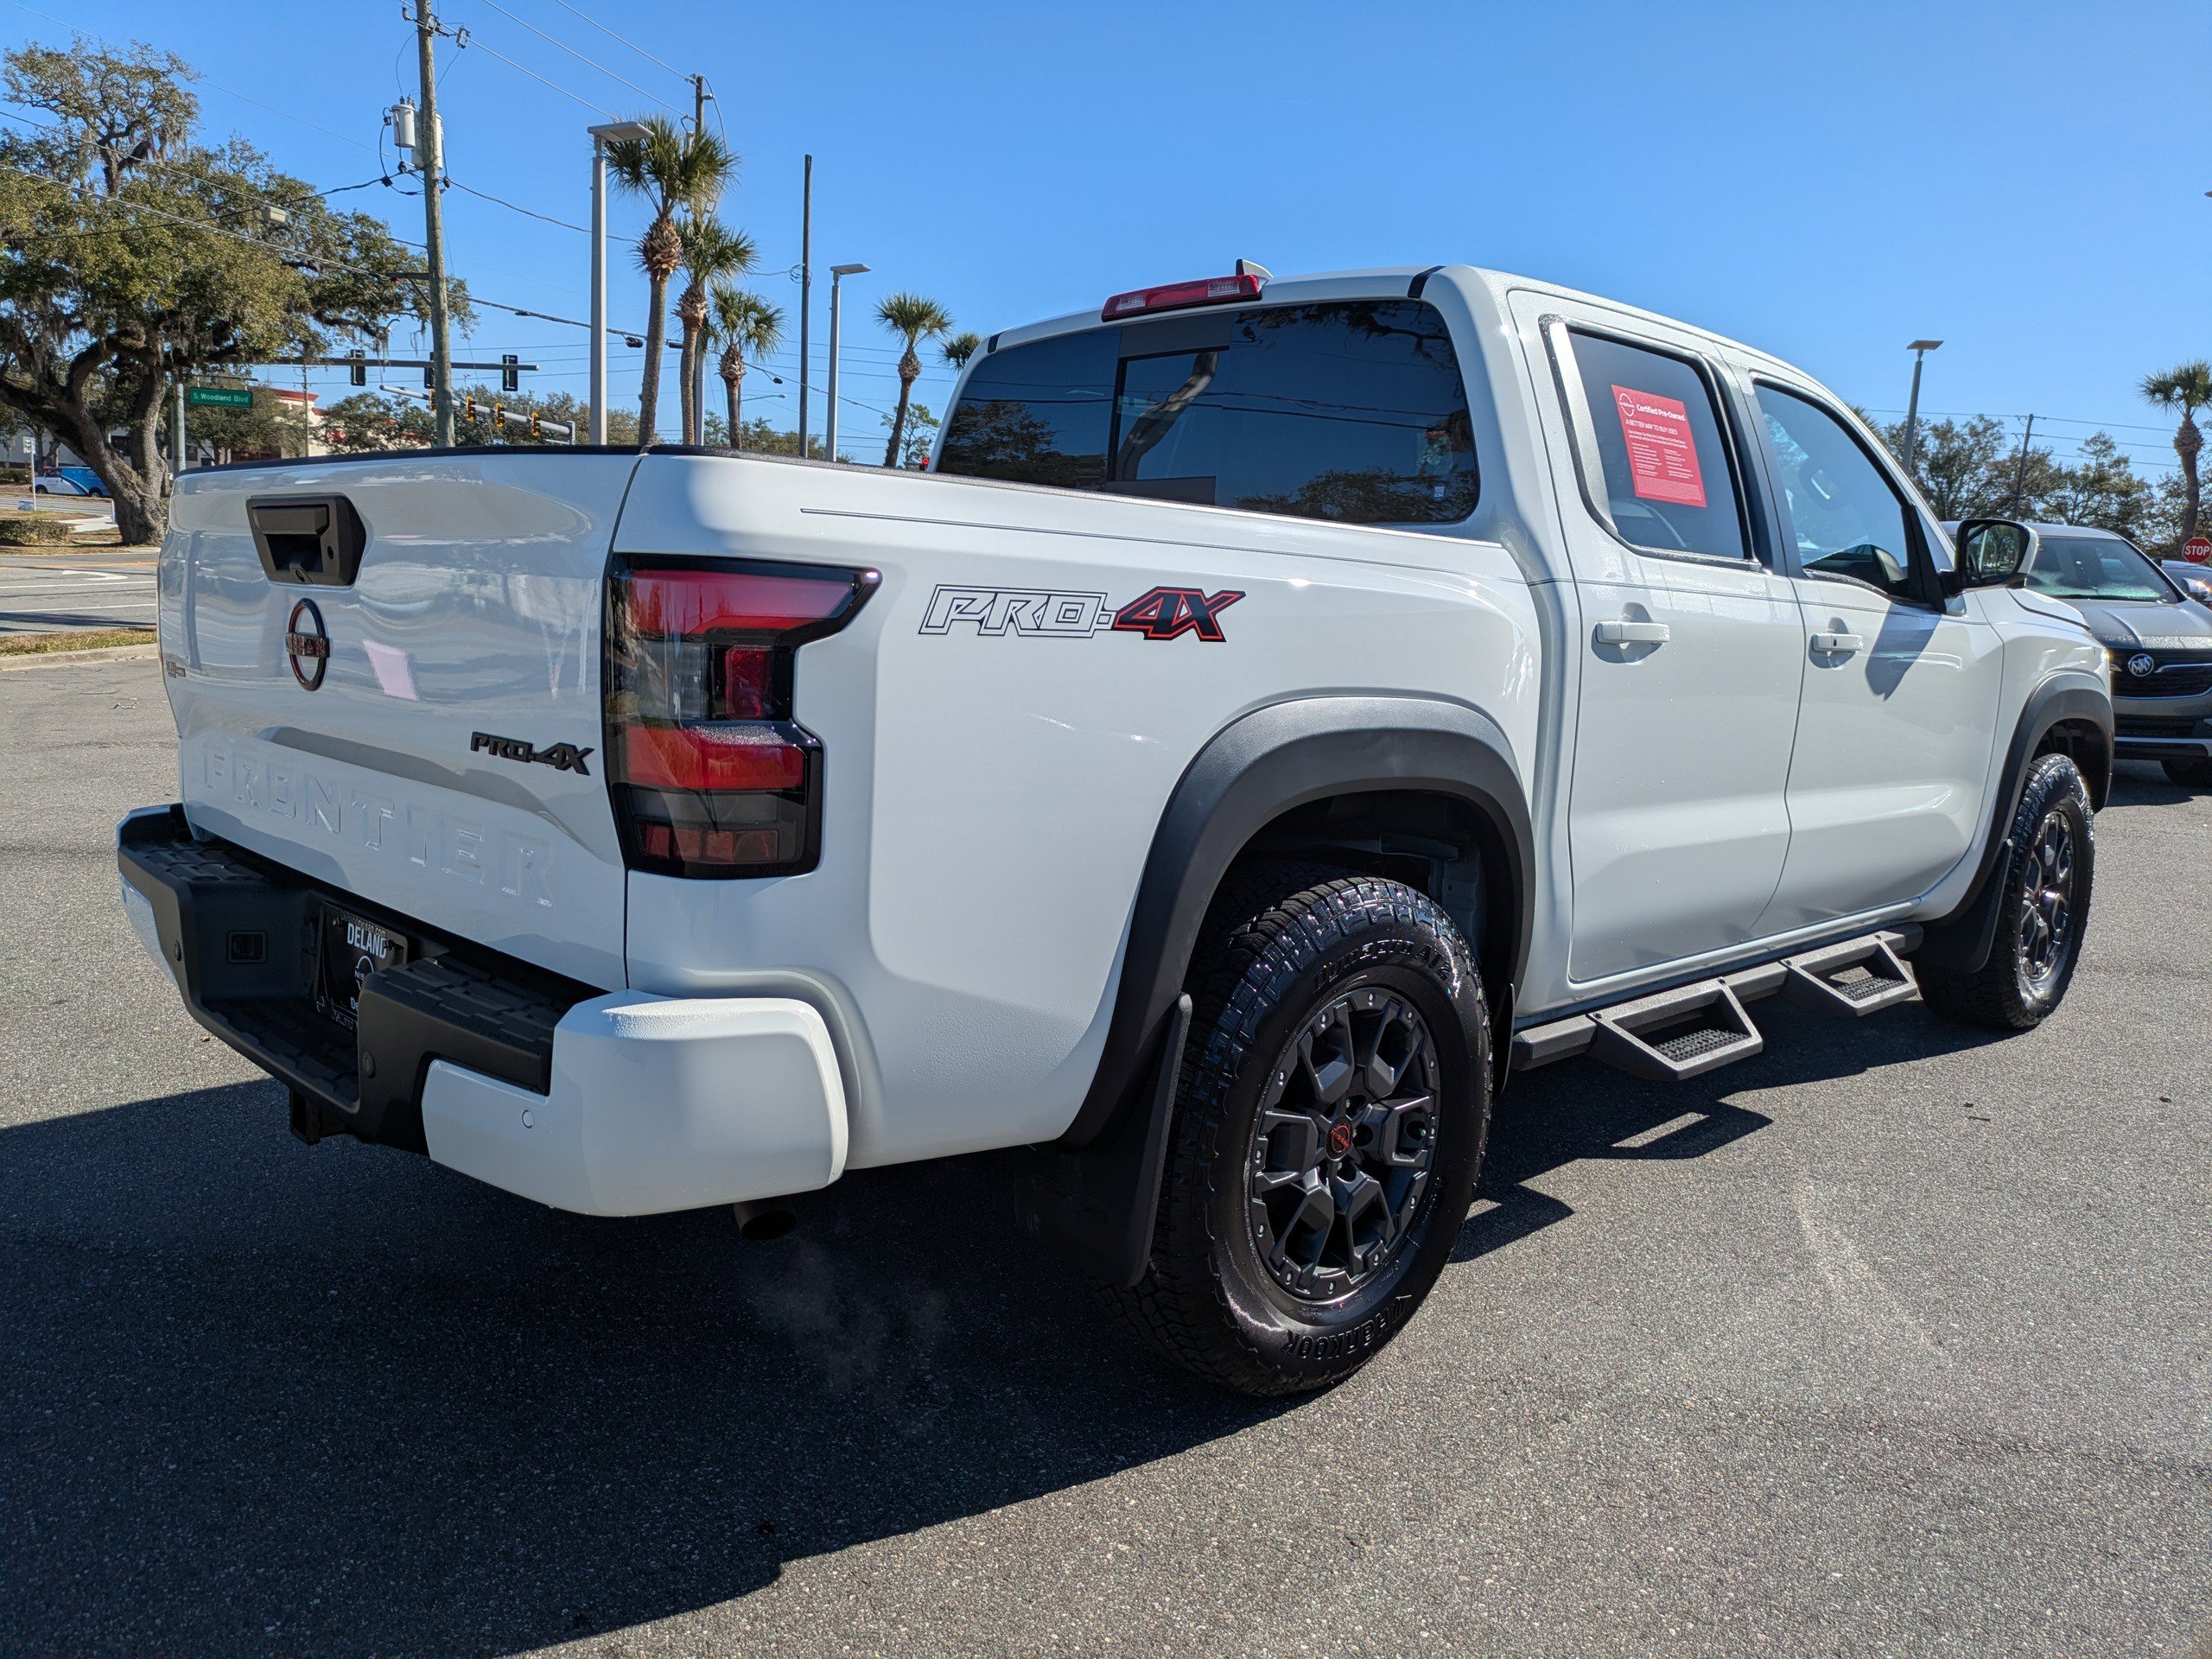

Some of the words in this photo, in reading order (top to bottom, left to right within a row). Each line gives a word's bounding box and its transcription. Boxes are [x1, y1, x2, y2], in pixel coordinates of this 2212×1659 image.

[200, 392, 232, 402] Woodland
[2184, 545, 2210, 556] STOP
[918, 583, 1247, 643] PRO-4X
[470, 731, 596, 777] PRO-4X
[202, 741, 556, 908] FRONTIER
[346, 922, 388, 959] DELAND
